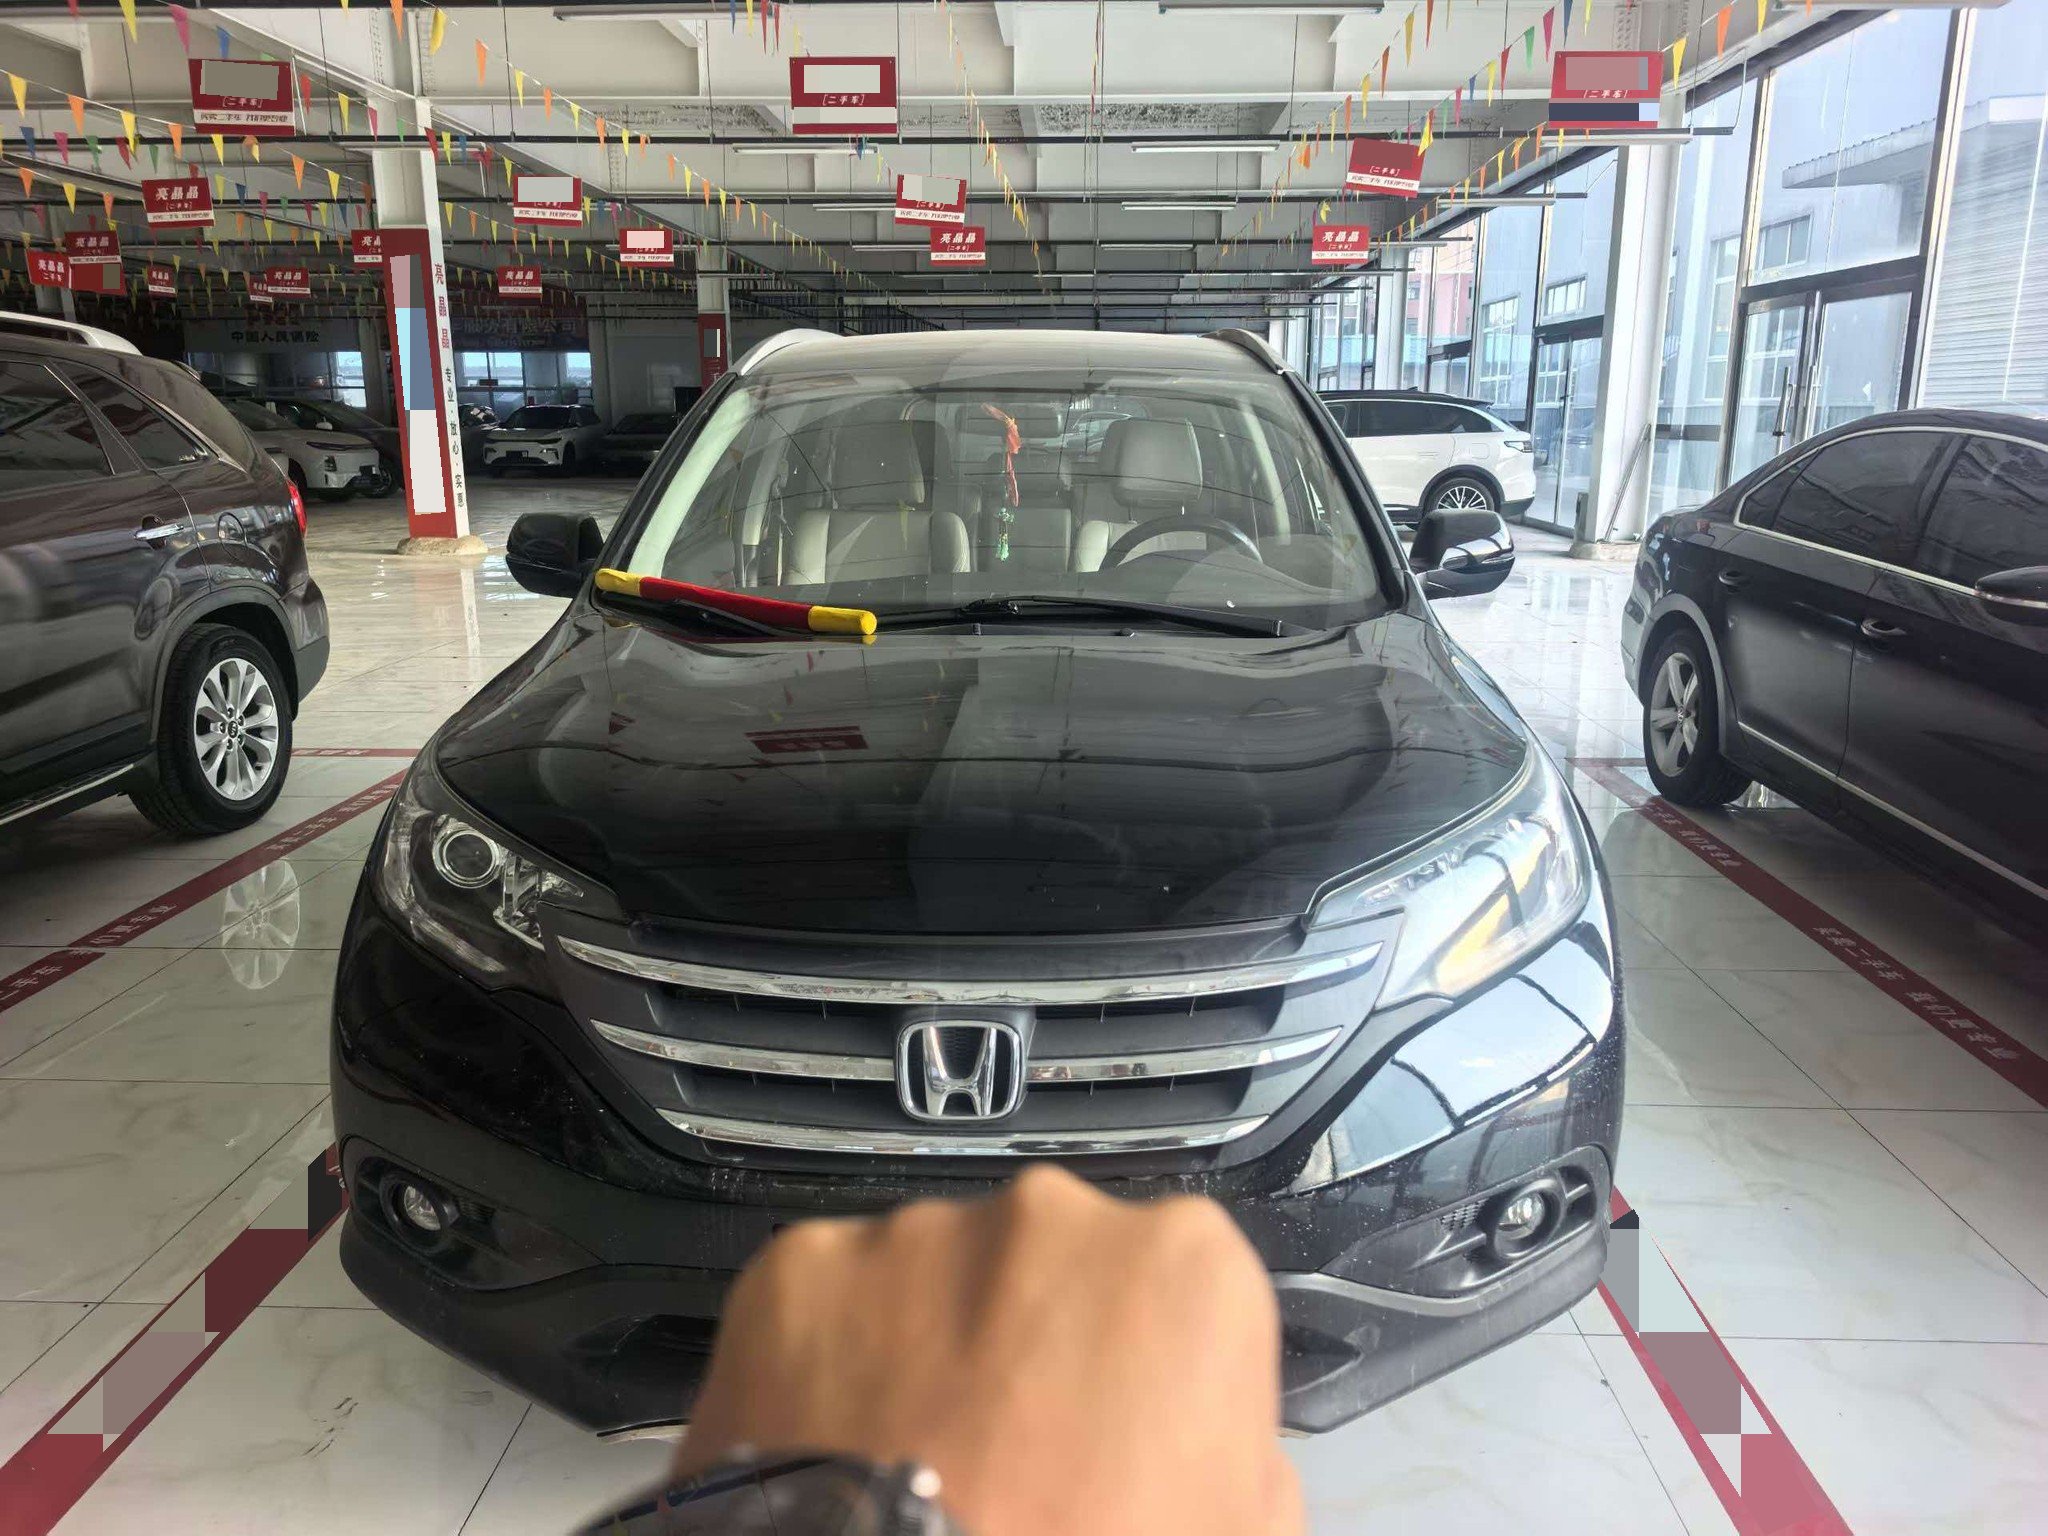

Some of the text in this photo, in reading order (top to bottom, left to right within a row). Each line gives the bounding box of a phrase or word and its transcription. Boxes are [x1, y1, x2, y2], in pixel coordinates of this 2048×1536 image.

[155, 185, 199, 202] 亮晶晶
[939, 232, 977, 245] 亮晶晶
[1321, 230, 1360, 243] 亮晶晶
